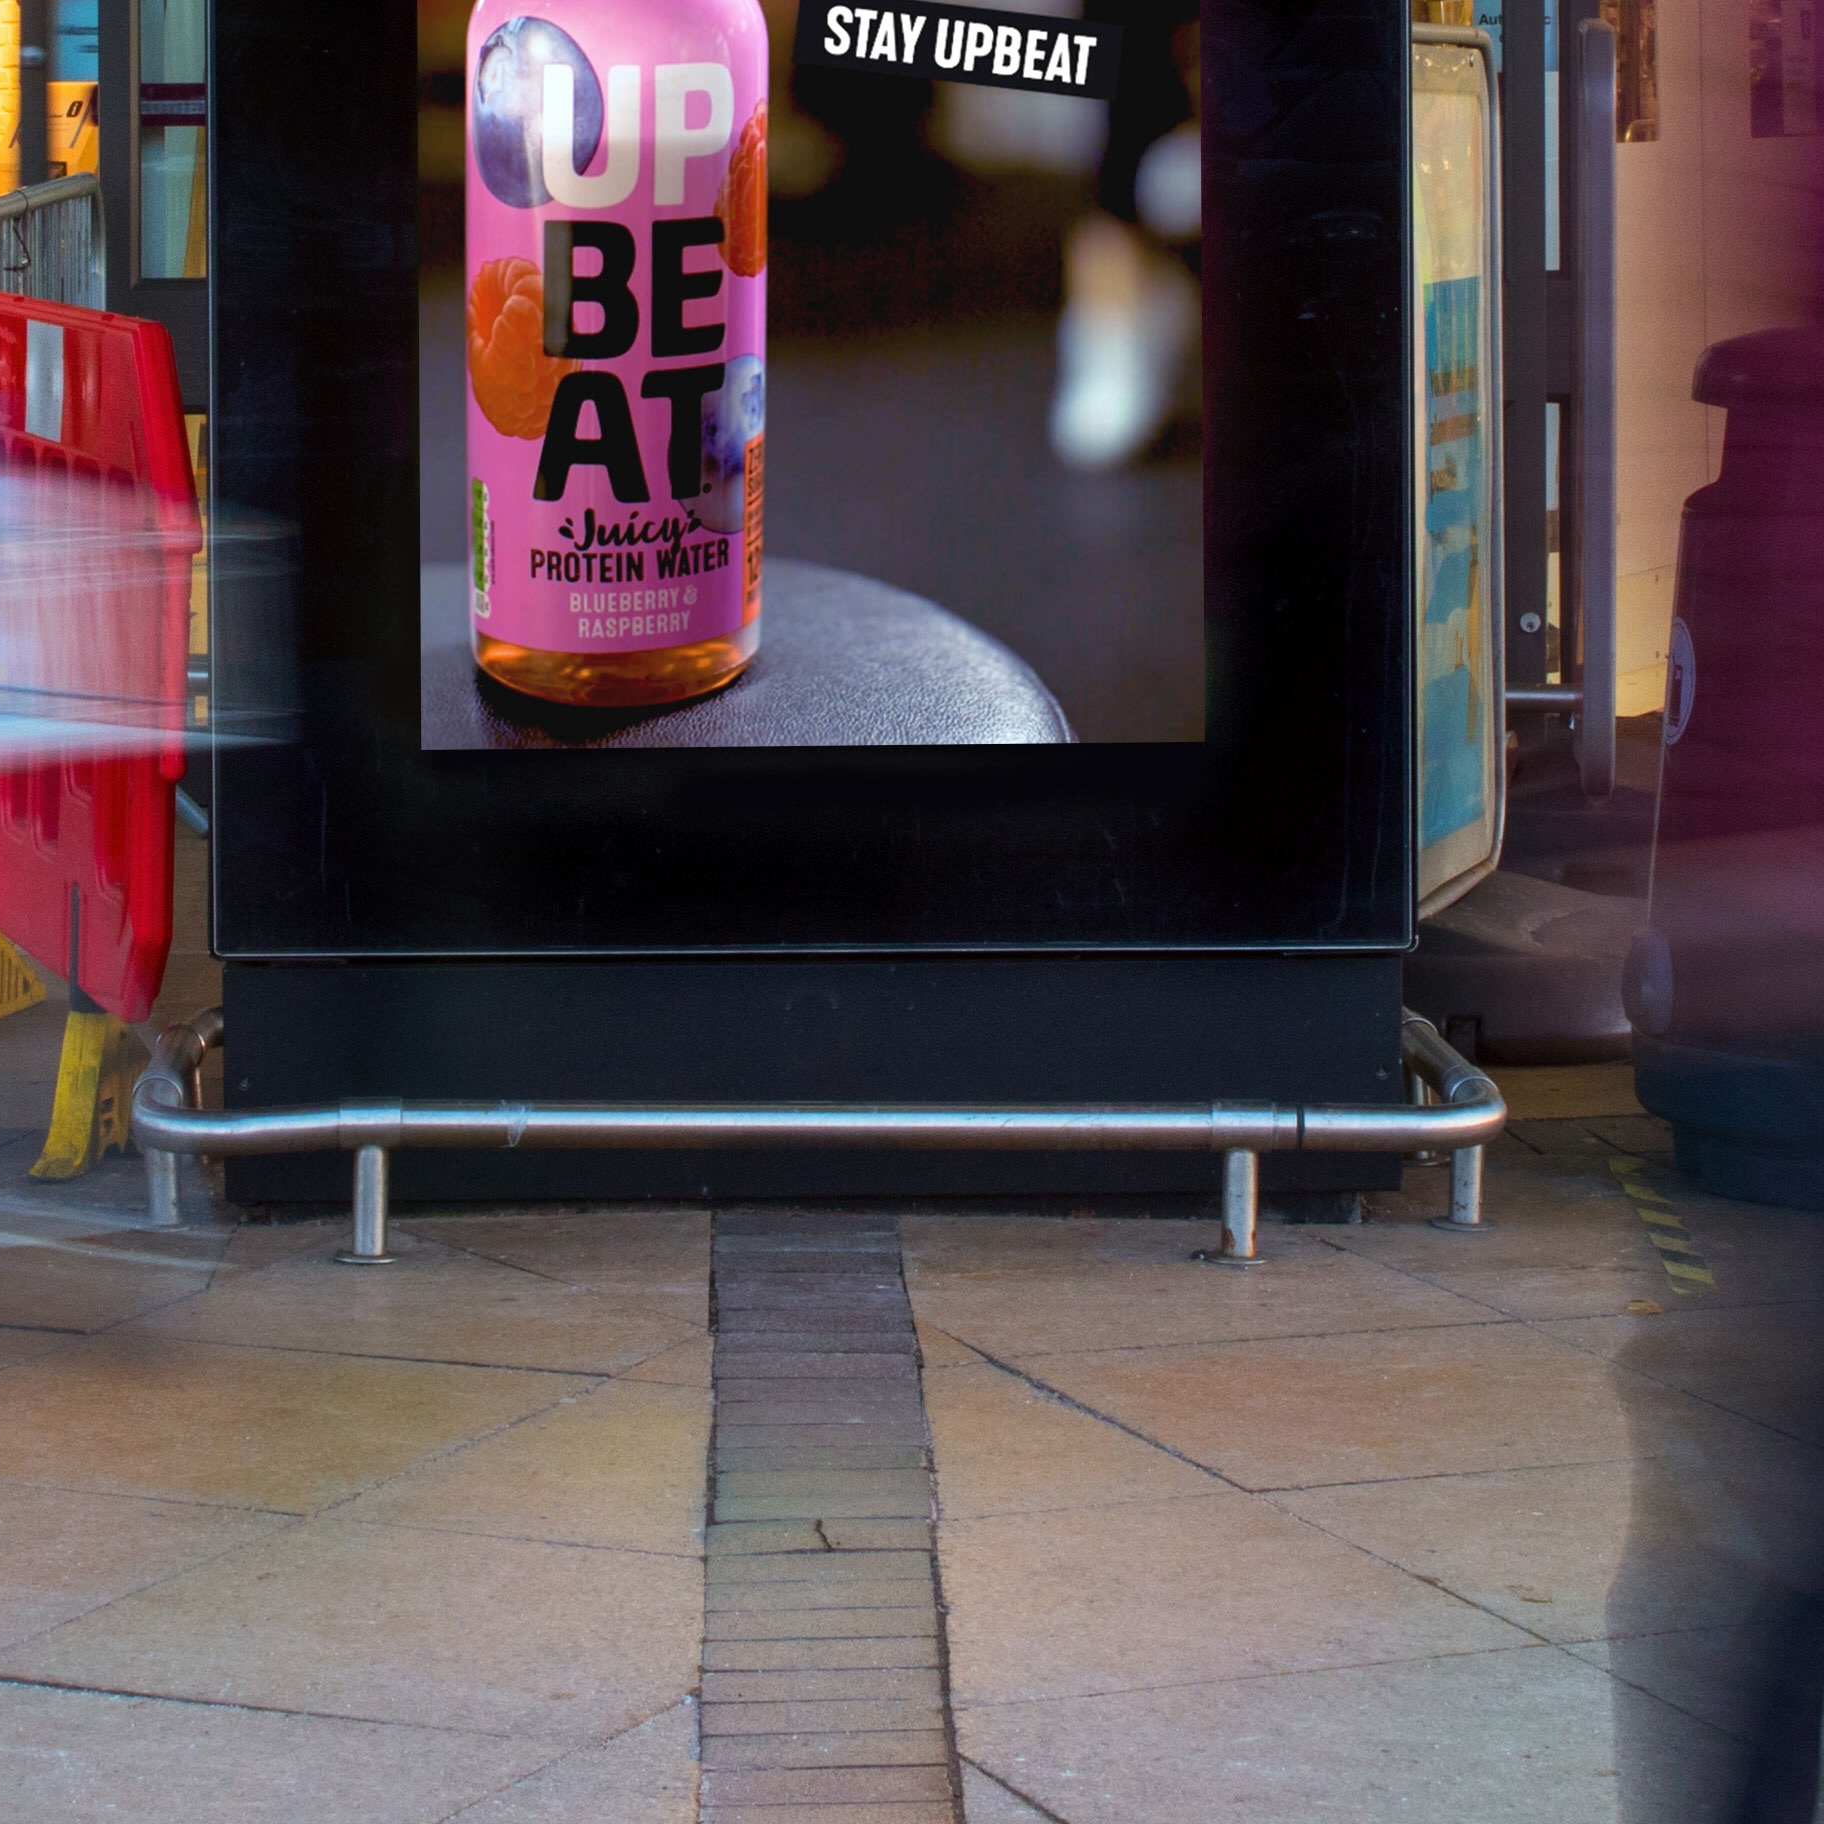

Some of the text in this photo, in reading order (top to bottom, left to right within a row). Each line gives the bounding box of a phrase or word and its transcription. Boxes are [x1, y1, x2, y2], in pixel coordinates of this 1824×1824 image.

[822, 4, 1098, 86] STAY UPBEAT
[541, 60, 736, 209] UP
[542, 215, 726, 361] BE
[531, 367, 726, 503] AT
[530, 537, 730, 584] PROTEIN WATER
[573, 507, 691, 554] Juicy
[569, 584, 699, 614] BLUEBERRY &
[578, 610, 692, 639] RASPBERRY
